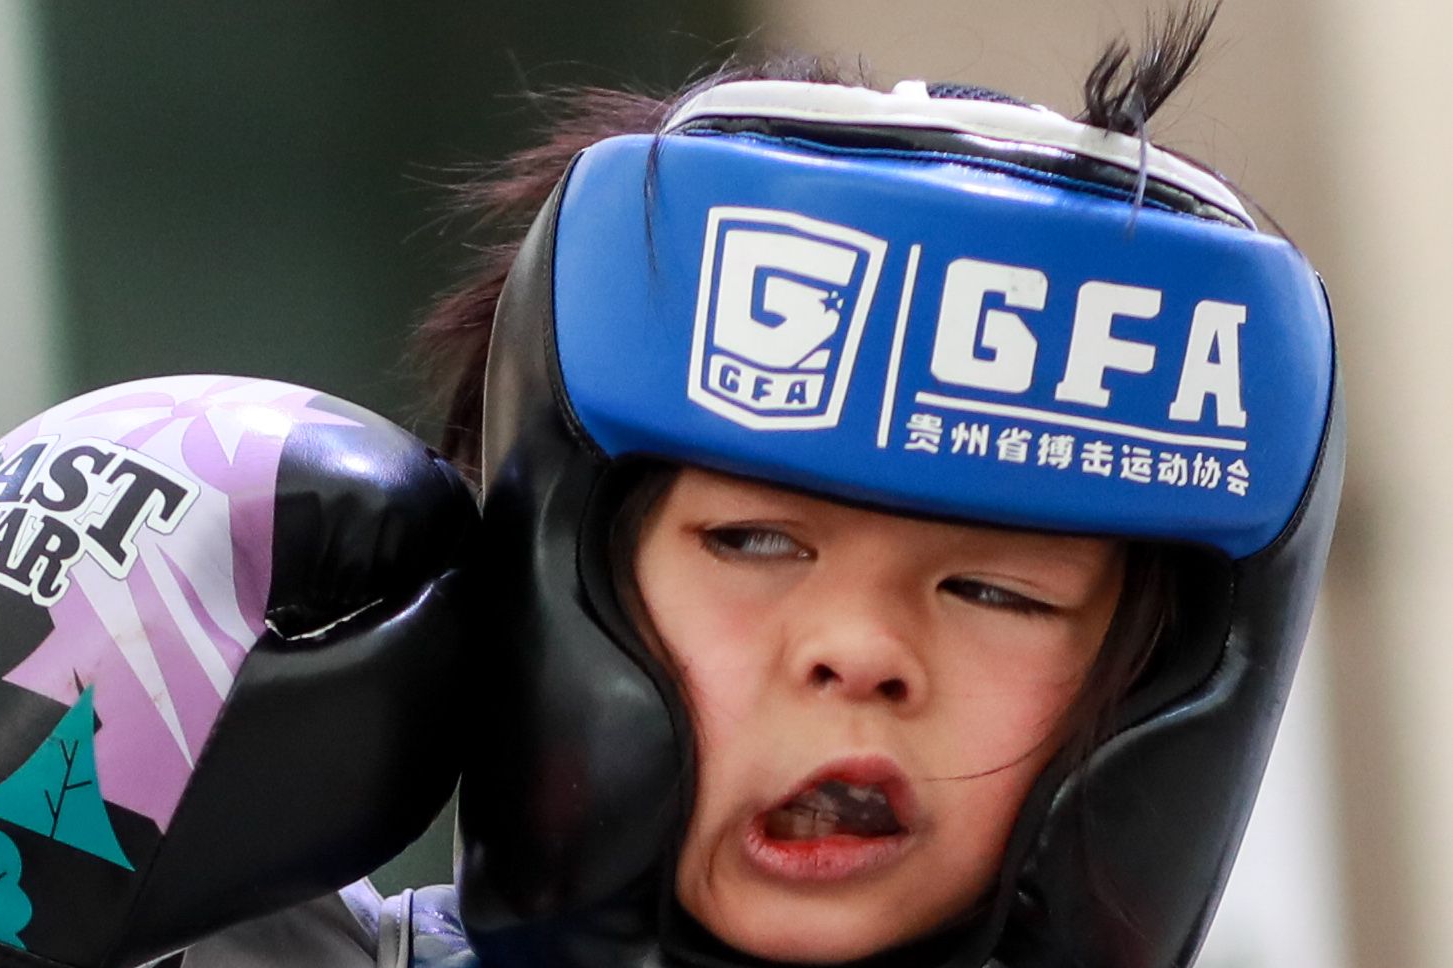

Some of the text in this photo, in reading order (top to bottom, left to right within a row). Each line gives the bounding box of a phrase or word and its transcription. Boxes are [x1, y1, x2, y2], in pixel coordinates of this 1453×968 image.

[718, 363, 809, 405] GFA
[930, 257, 1248, 428] GFA
[904, 412, 1250, 497] 贵州省搏击运动协会
